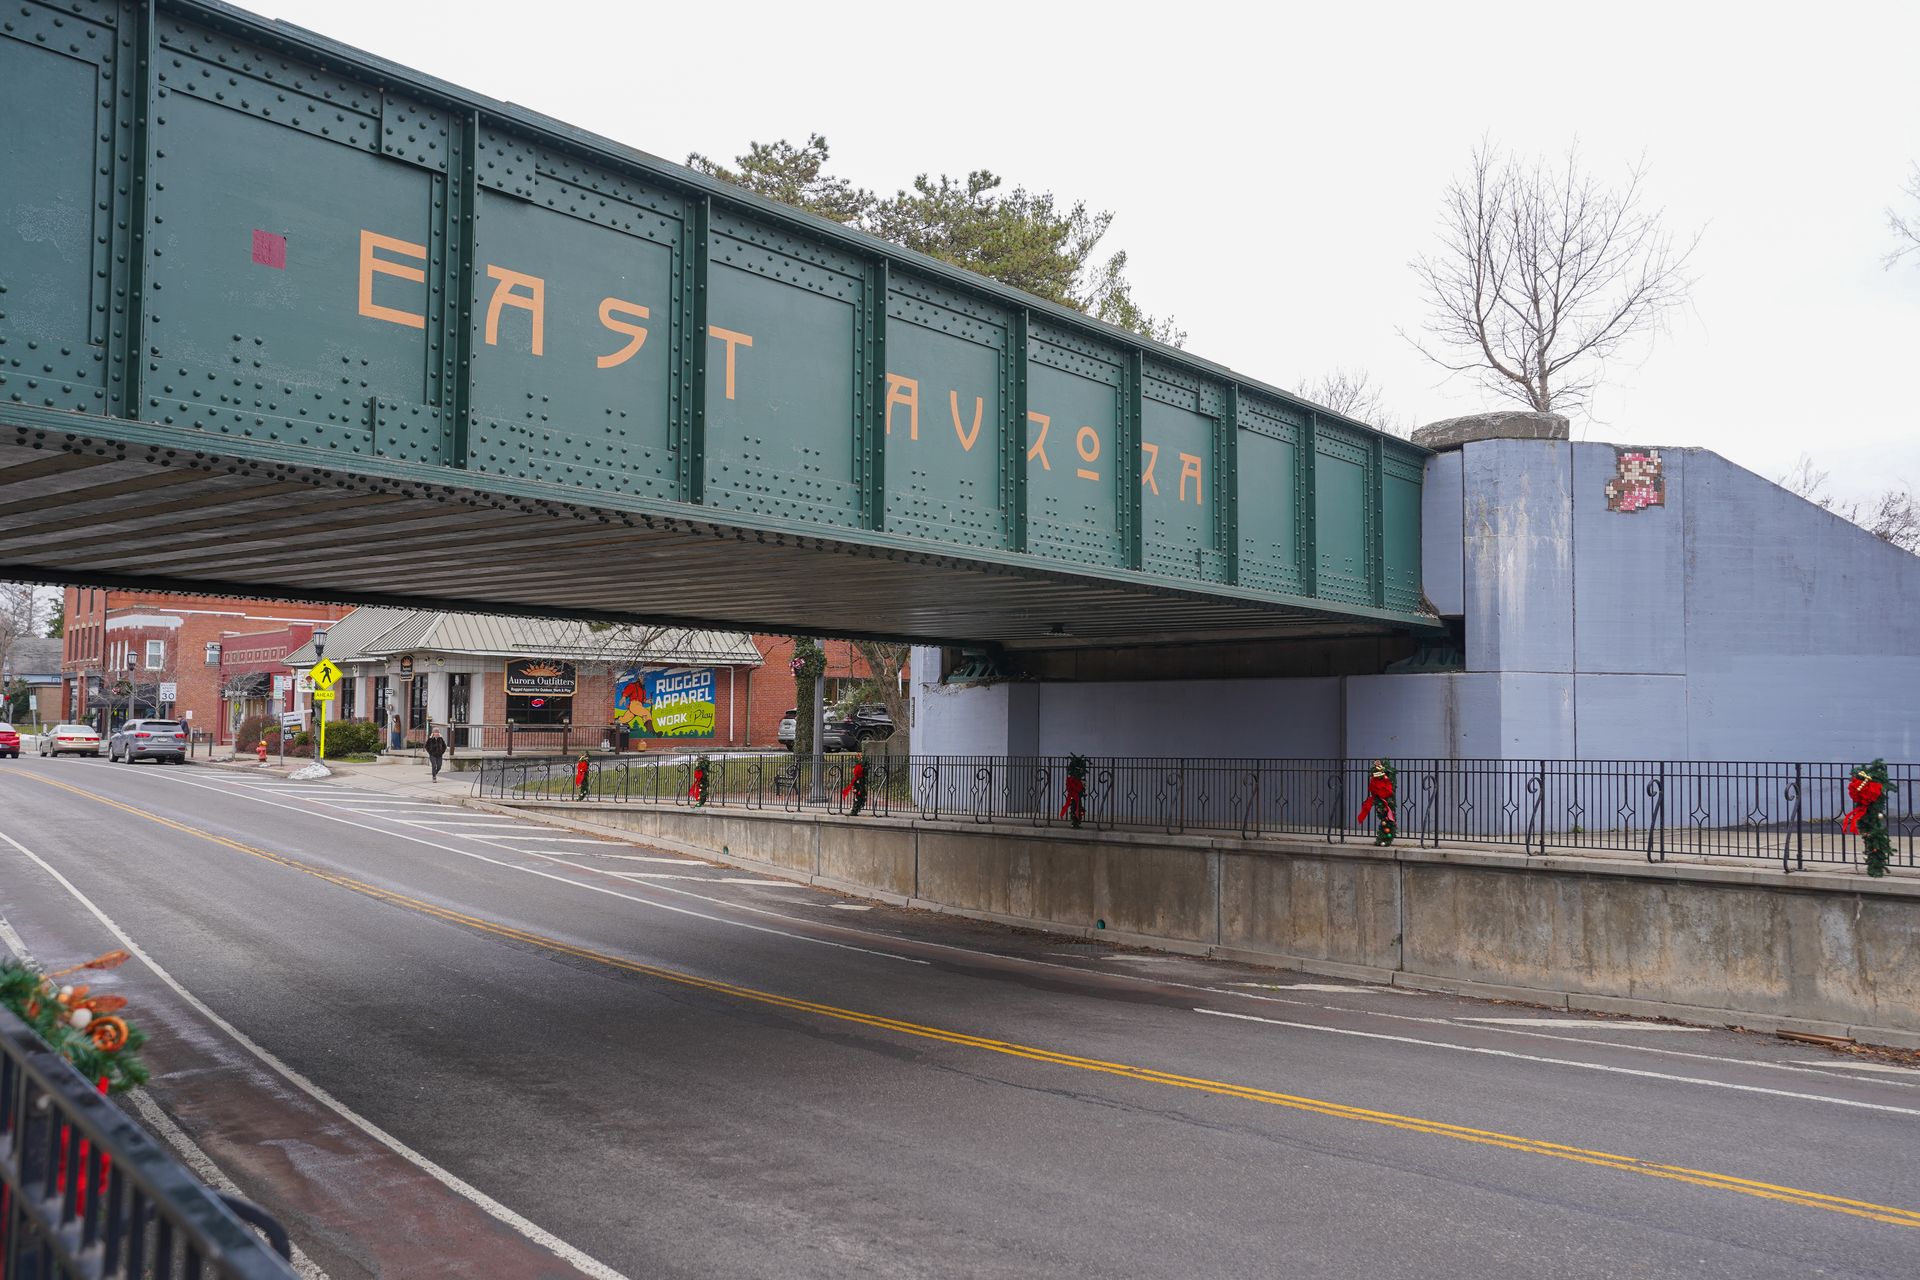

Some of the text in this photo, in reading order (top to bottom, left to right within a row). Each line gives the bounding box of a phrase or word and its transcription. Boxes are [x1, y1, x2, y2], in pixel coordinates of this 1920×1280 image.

[358, 229, 754, 401] EAST
[508, 676, 575, 686] Aurora Outfitters
[656, 671, 711, 694] RUGGED
[161, 692, 175, 700] 30
[654, 687, 712, 710] APPAREL
[656, 712, 688, 727] WORK
[693, 709, 713, 727] Play
